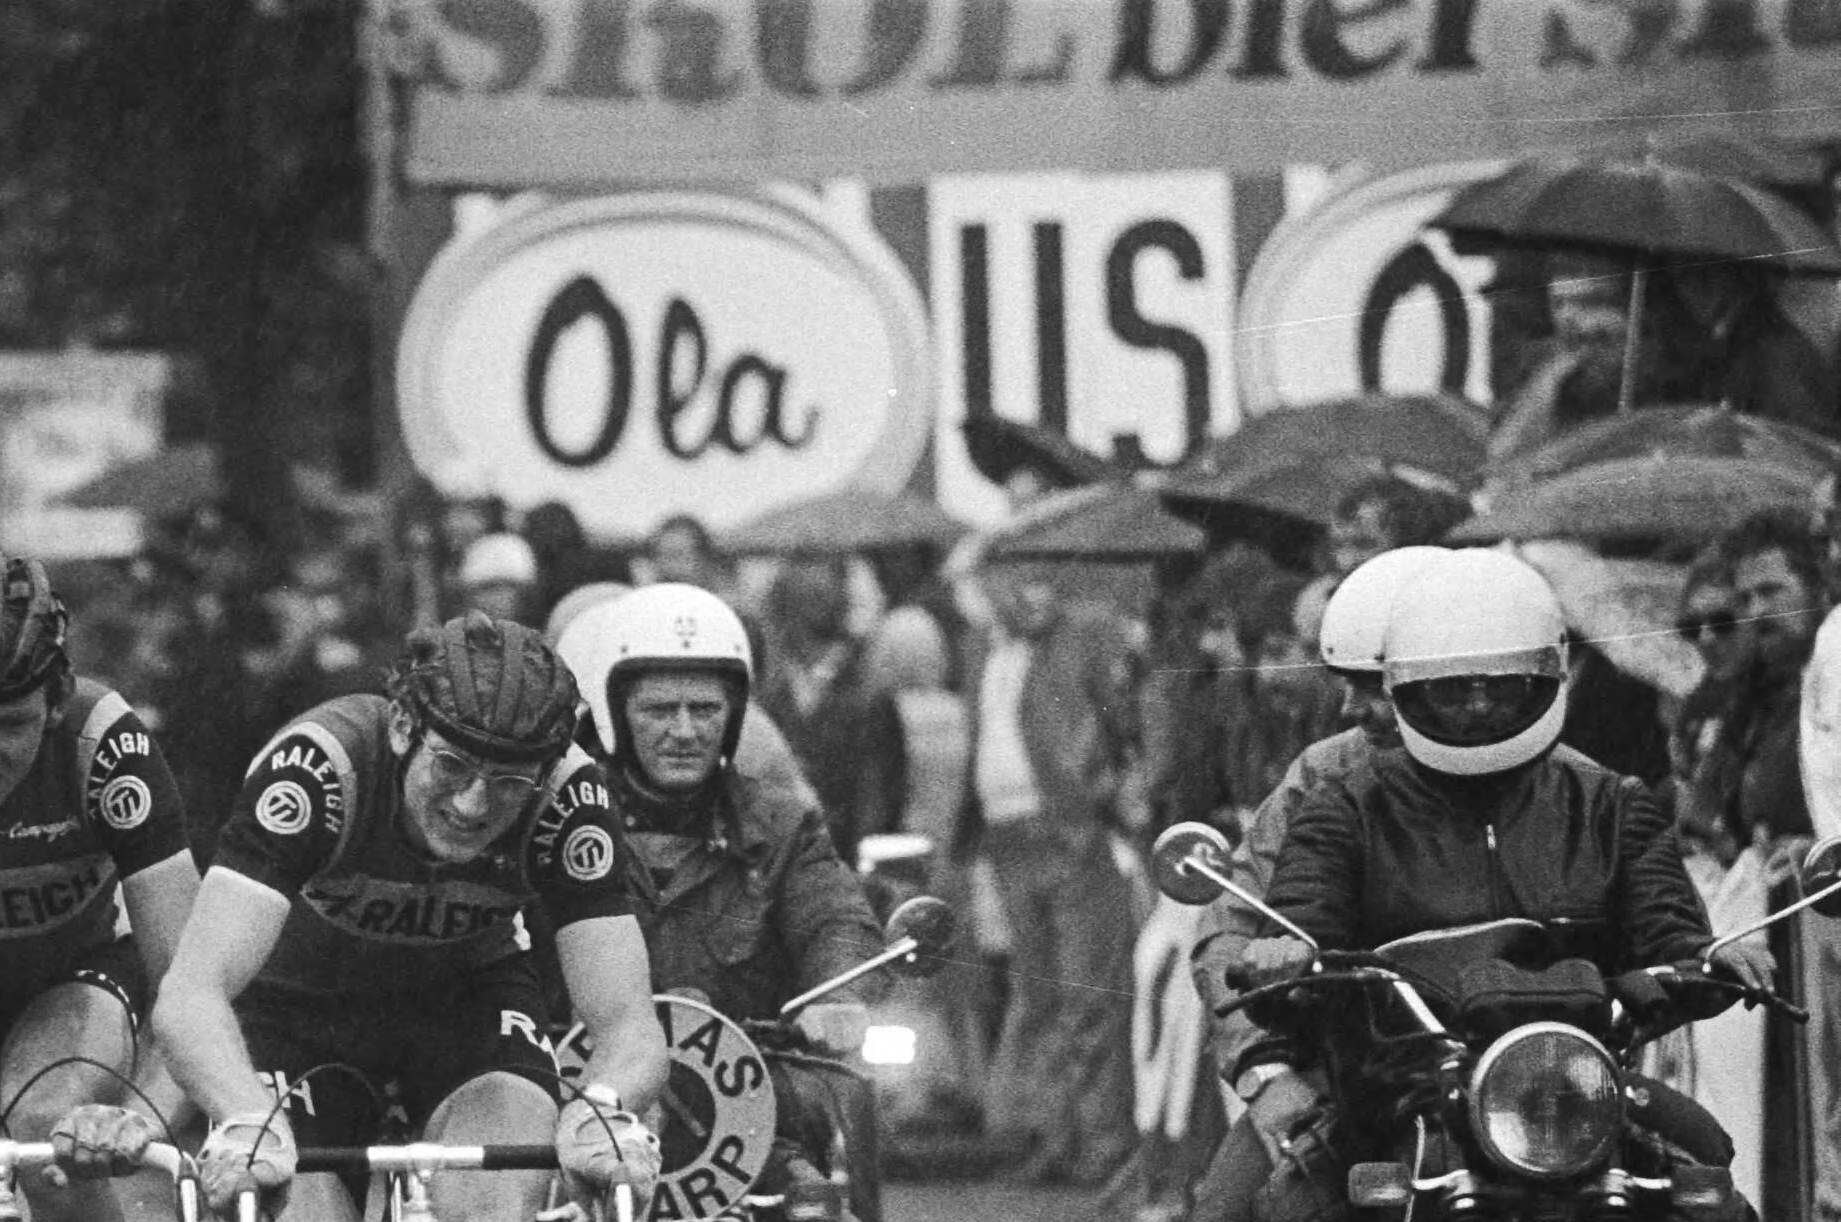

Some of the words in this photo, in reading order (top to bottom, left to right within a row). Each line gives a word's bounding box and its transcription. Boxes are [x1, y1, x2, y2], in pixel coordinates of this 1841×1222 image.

[525, 273, 820, 467] Ola
[271, 745, 345, 834] RALEIGH
[533, 780, 611, 867] RALEIGH
